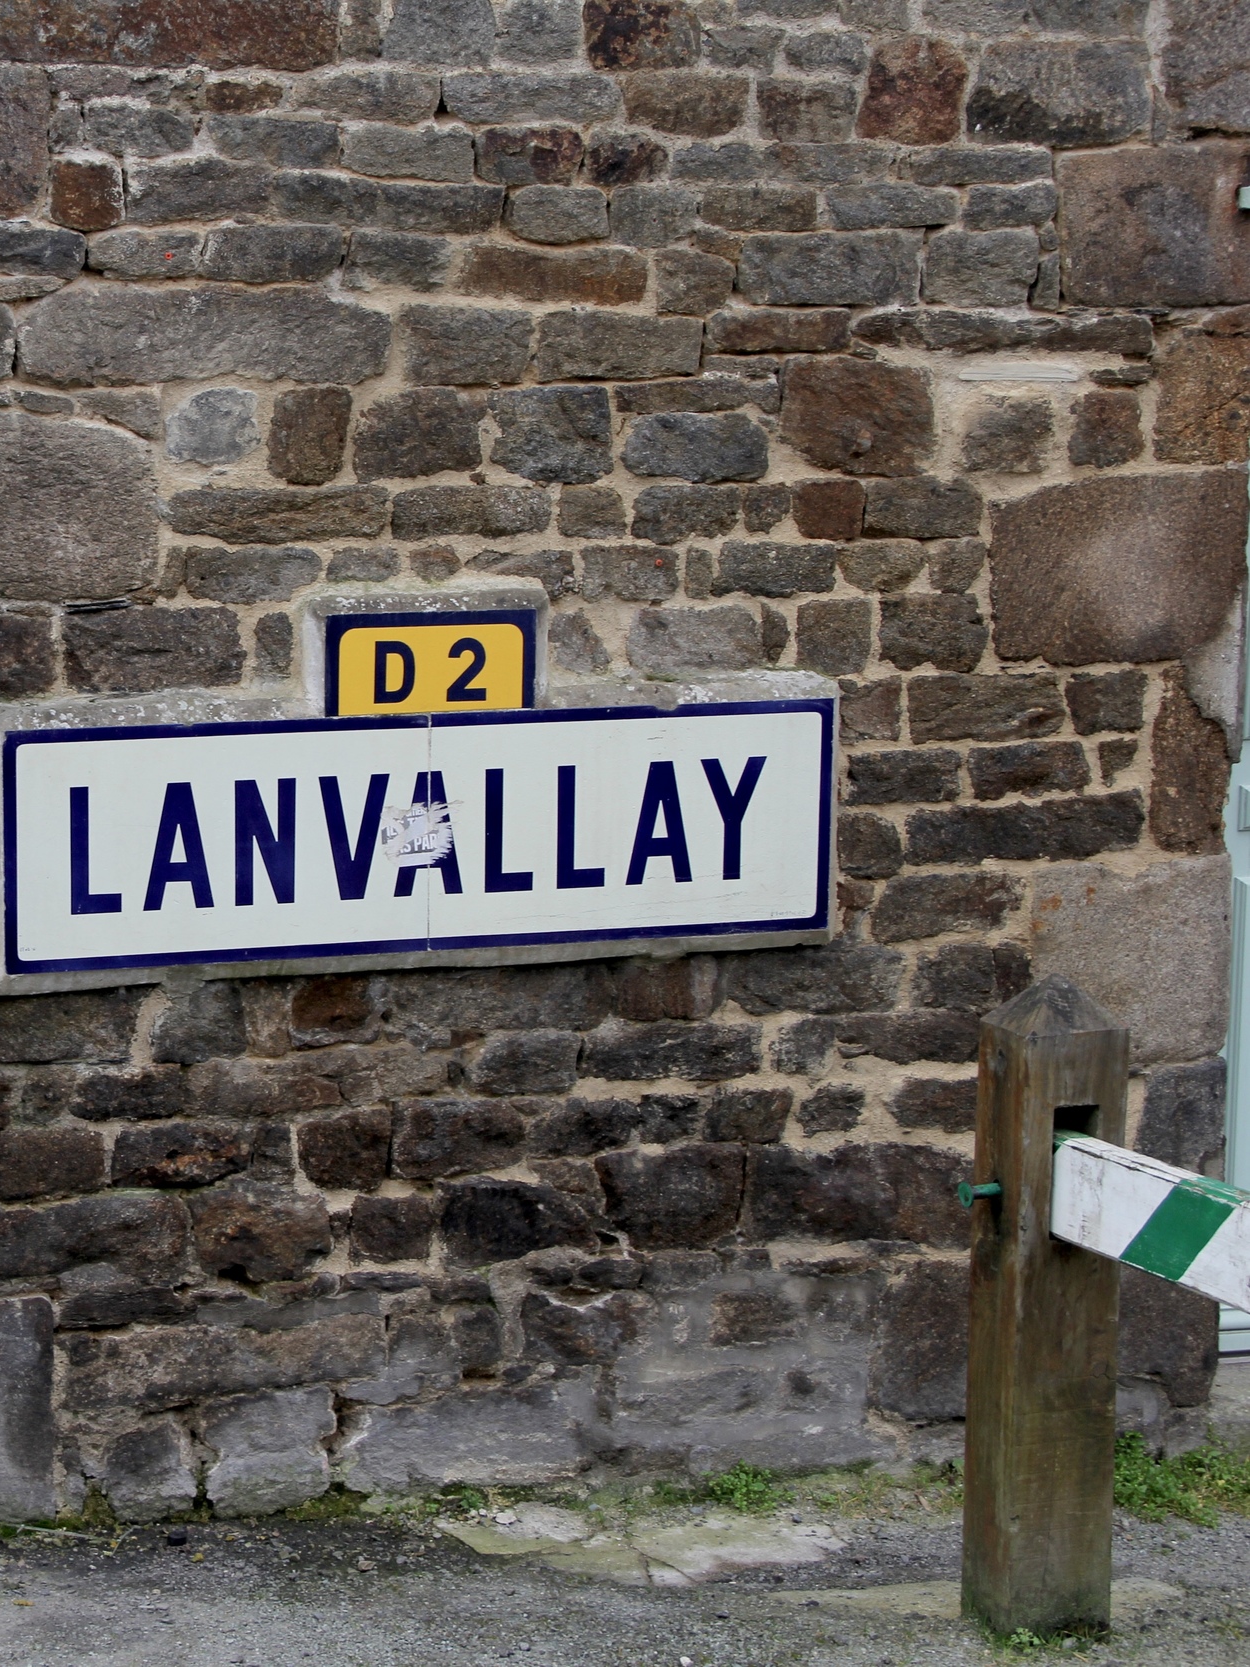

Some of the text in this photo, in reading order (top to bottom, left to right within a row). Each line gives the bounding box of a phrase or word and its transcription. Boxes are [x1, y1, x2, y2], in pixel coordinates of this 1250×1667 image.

[373, 637, 487, 705] D 2
[69, 756, 768, 916] LANVALLAY
